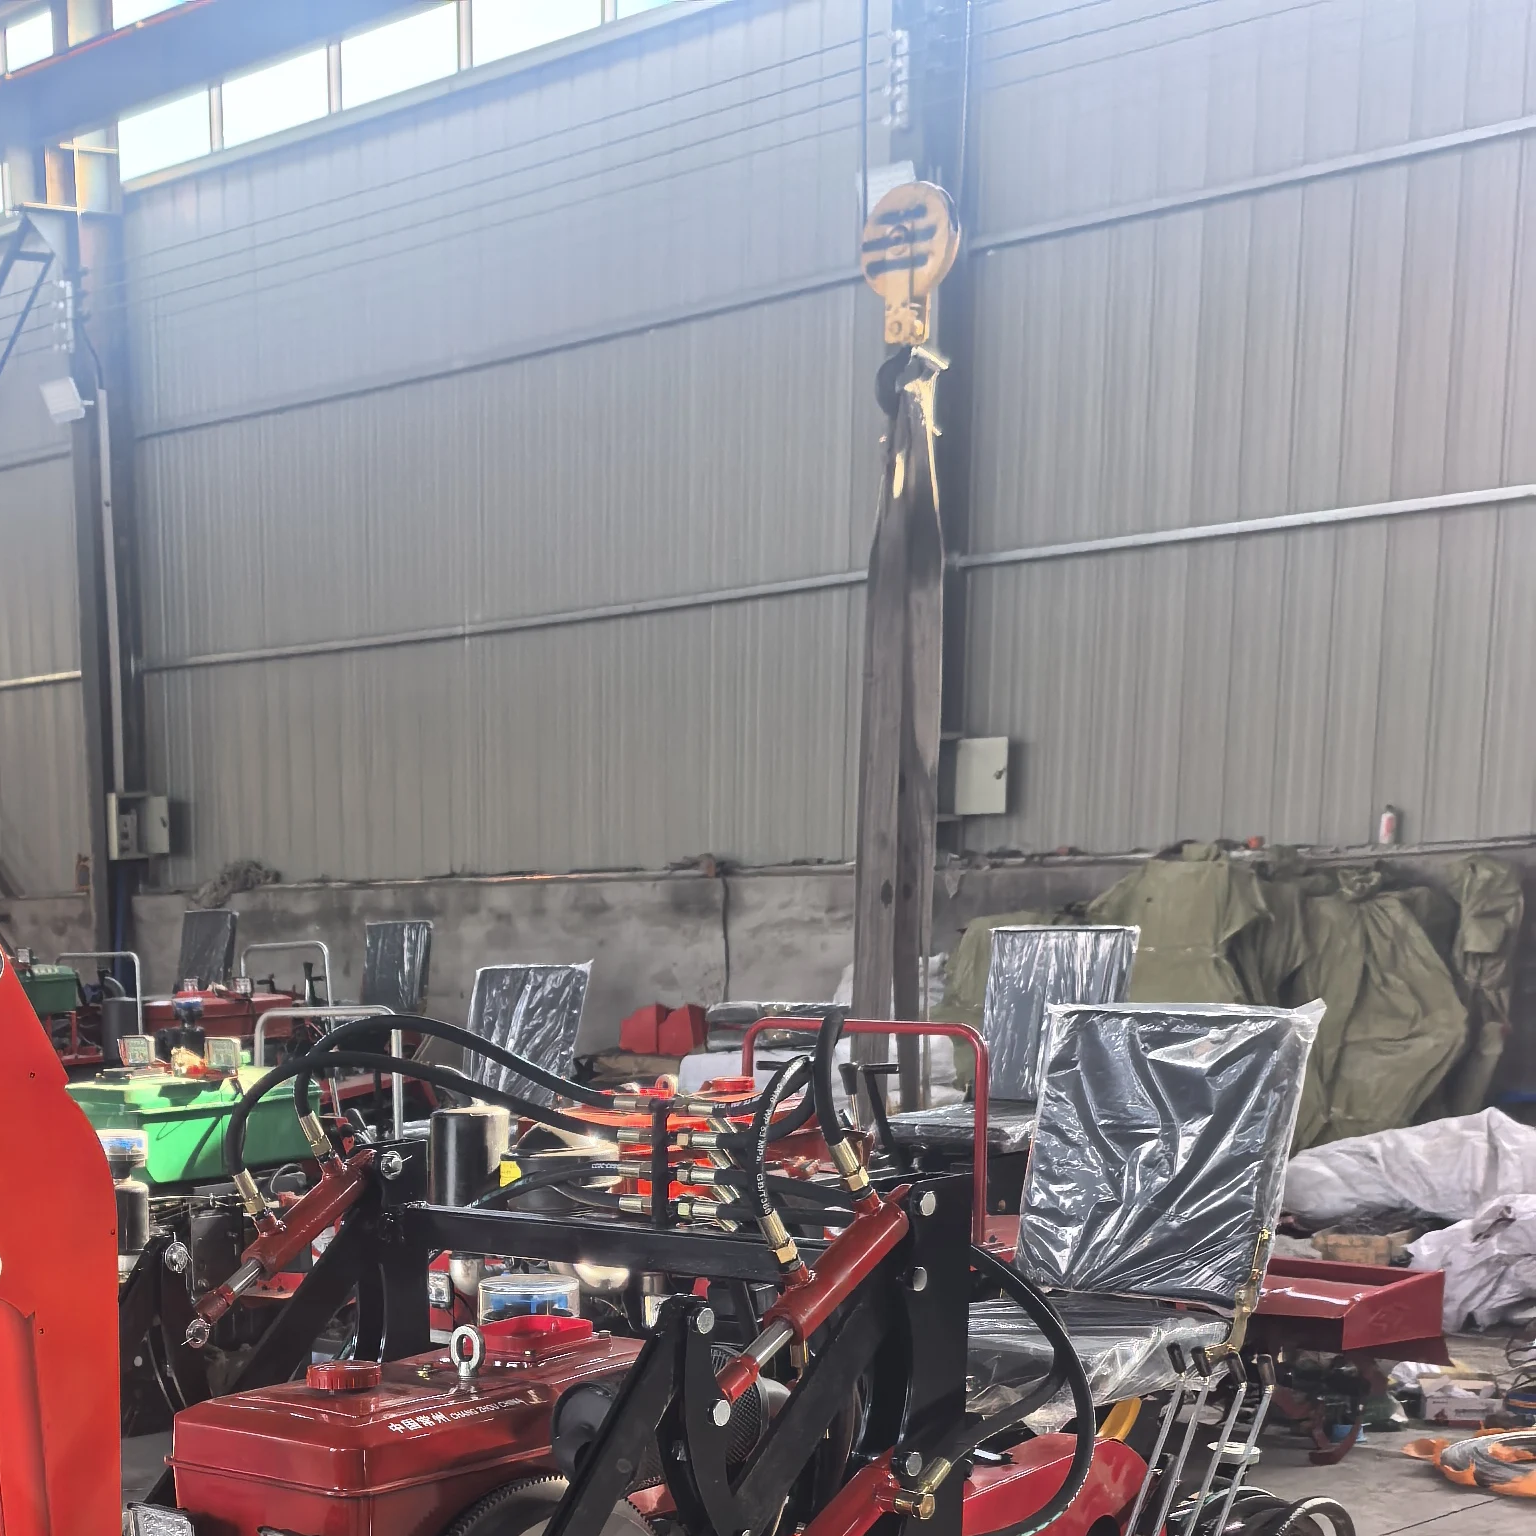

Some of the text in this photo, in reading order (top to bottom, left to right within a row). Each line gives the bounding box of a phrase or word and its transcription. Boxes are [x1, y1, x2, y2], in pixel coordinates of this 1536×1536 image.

[388, 1411, 451, 1434] 中国常州
[449, 1408, 478, 1420] CHANG
